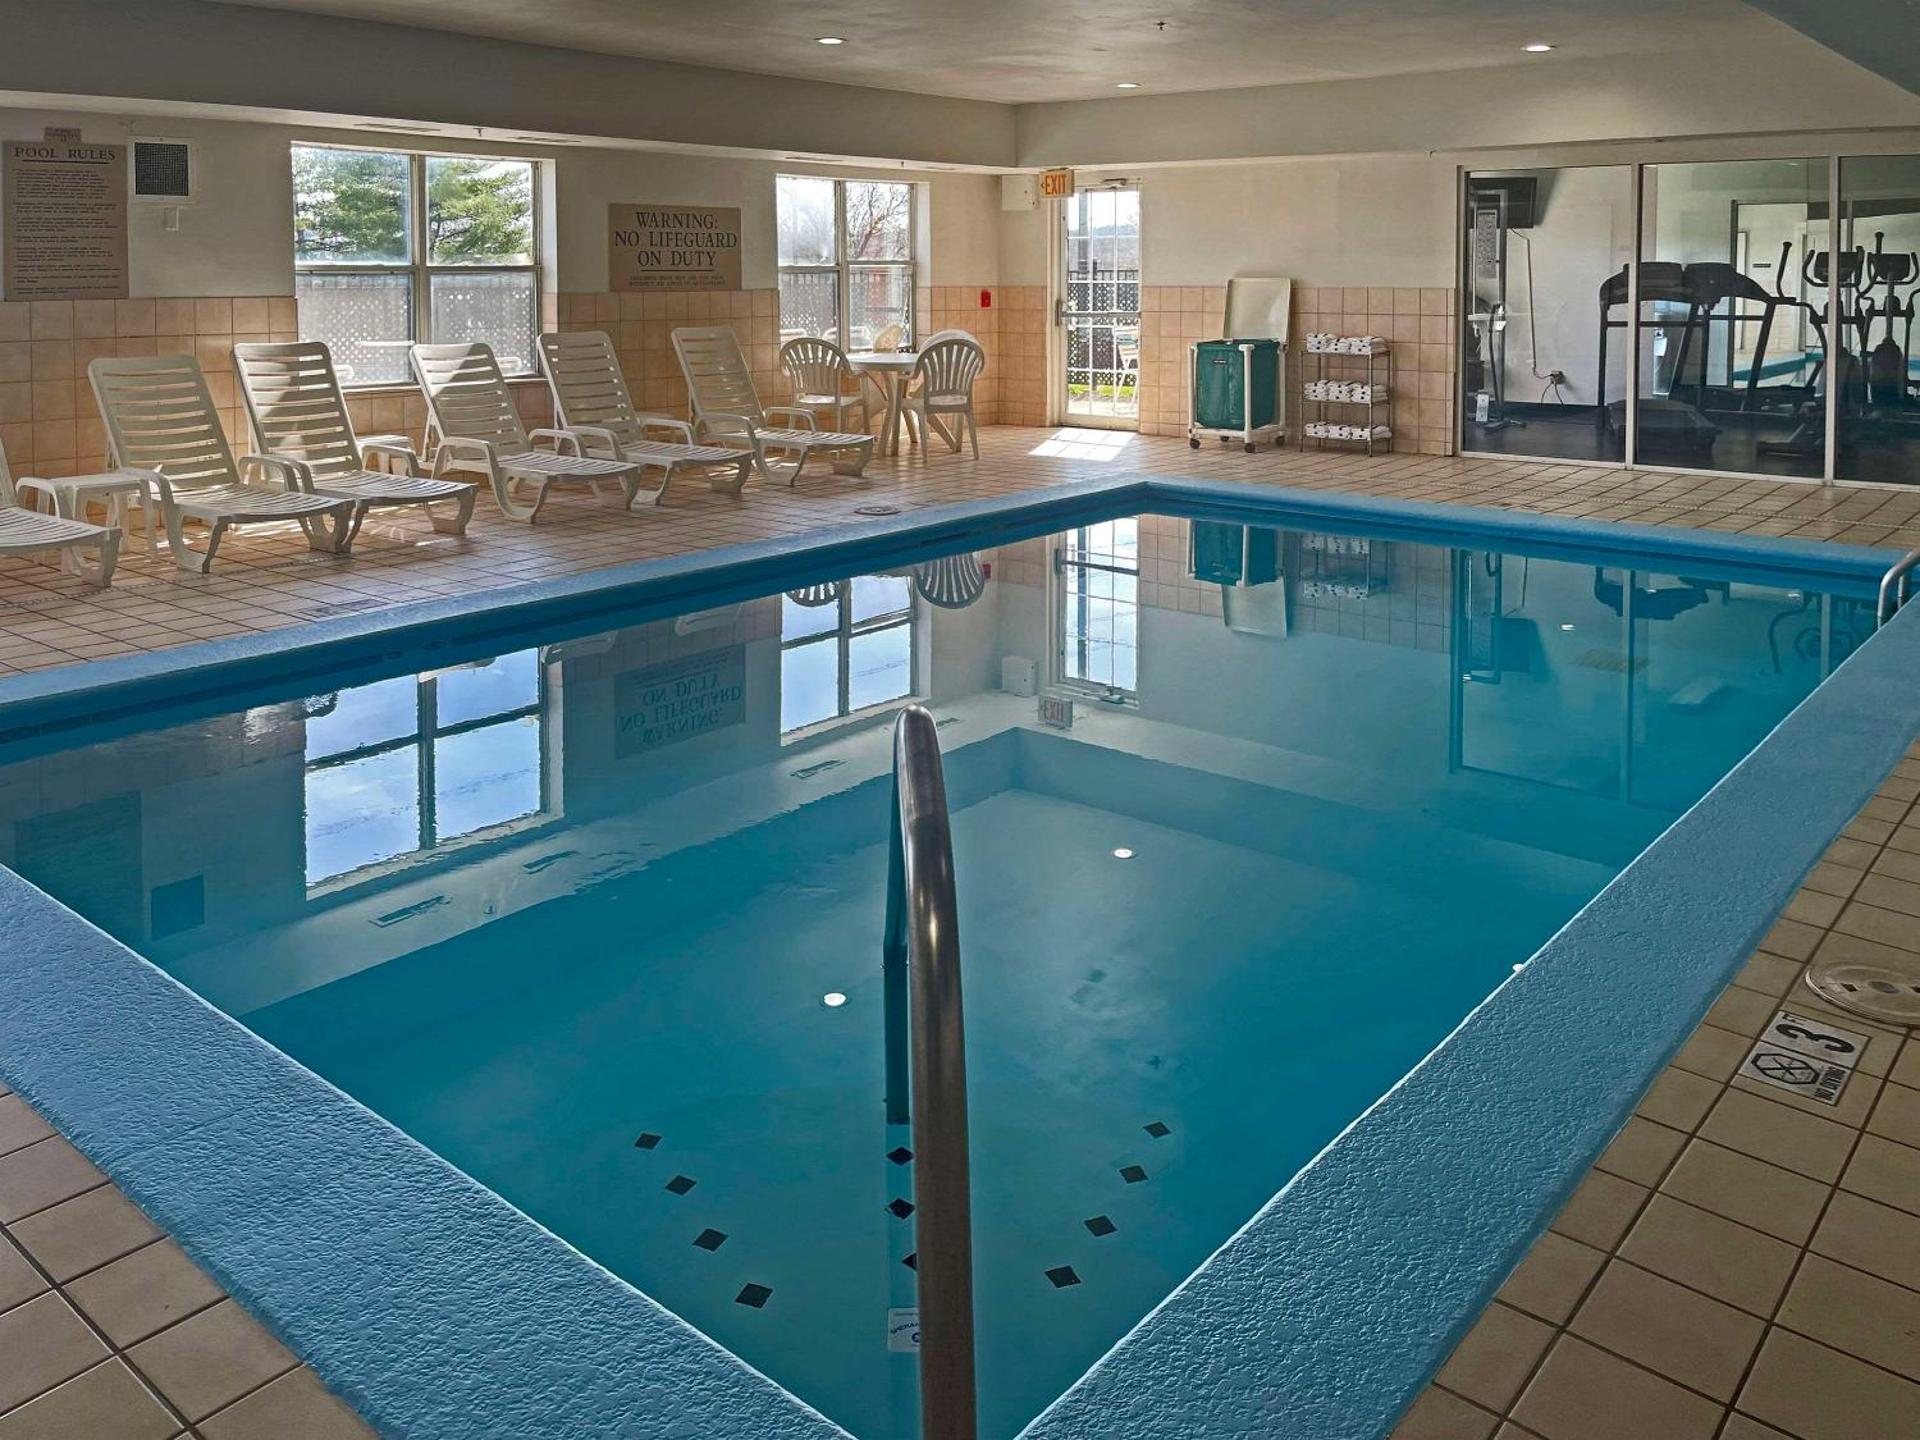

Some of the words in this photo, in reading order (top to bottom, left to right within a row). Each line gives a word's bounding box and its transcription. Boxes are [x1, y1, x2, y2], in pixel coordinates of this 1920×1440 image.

[15, 147, 58, 158] POOL
[68, 148, 116, 160] RULES
[1045, 174, 1067, 195] EXIT
[636, 212, 718, 229] WARNING:
[615, 231, 640, 247] NO
[649, 232, 737, 248] LIFEGUARD
[638, 251, 662, 266] ON
[671, 251, 717, 266] DUTY
[1775, 1023, 1855, 1053] 3
